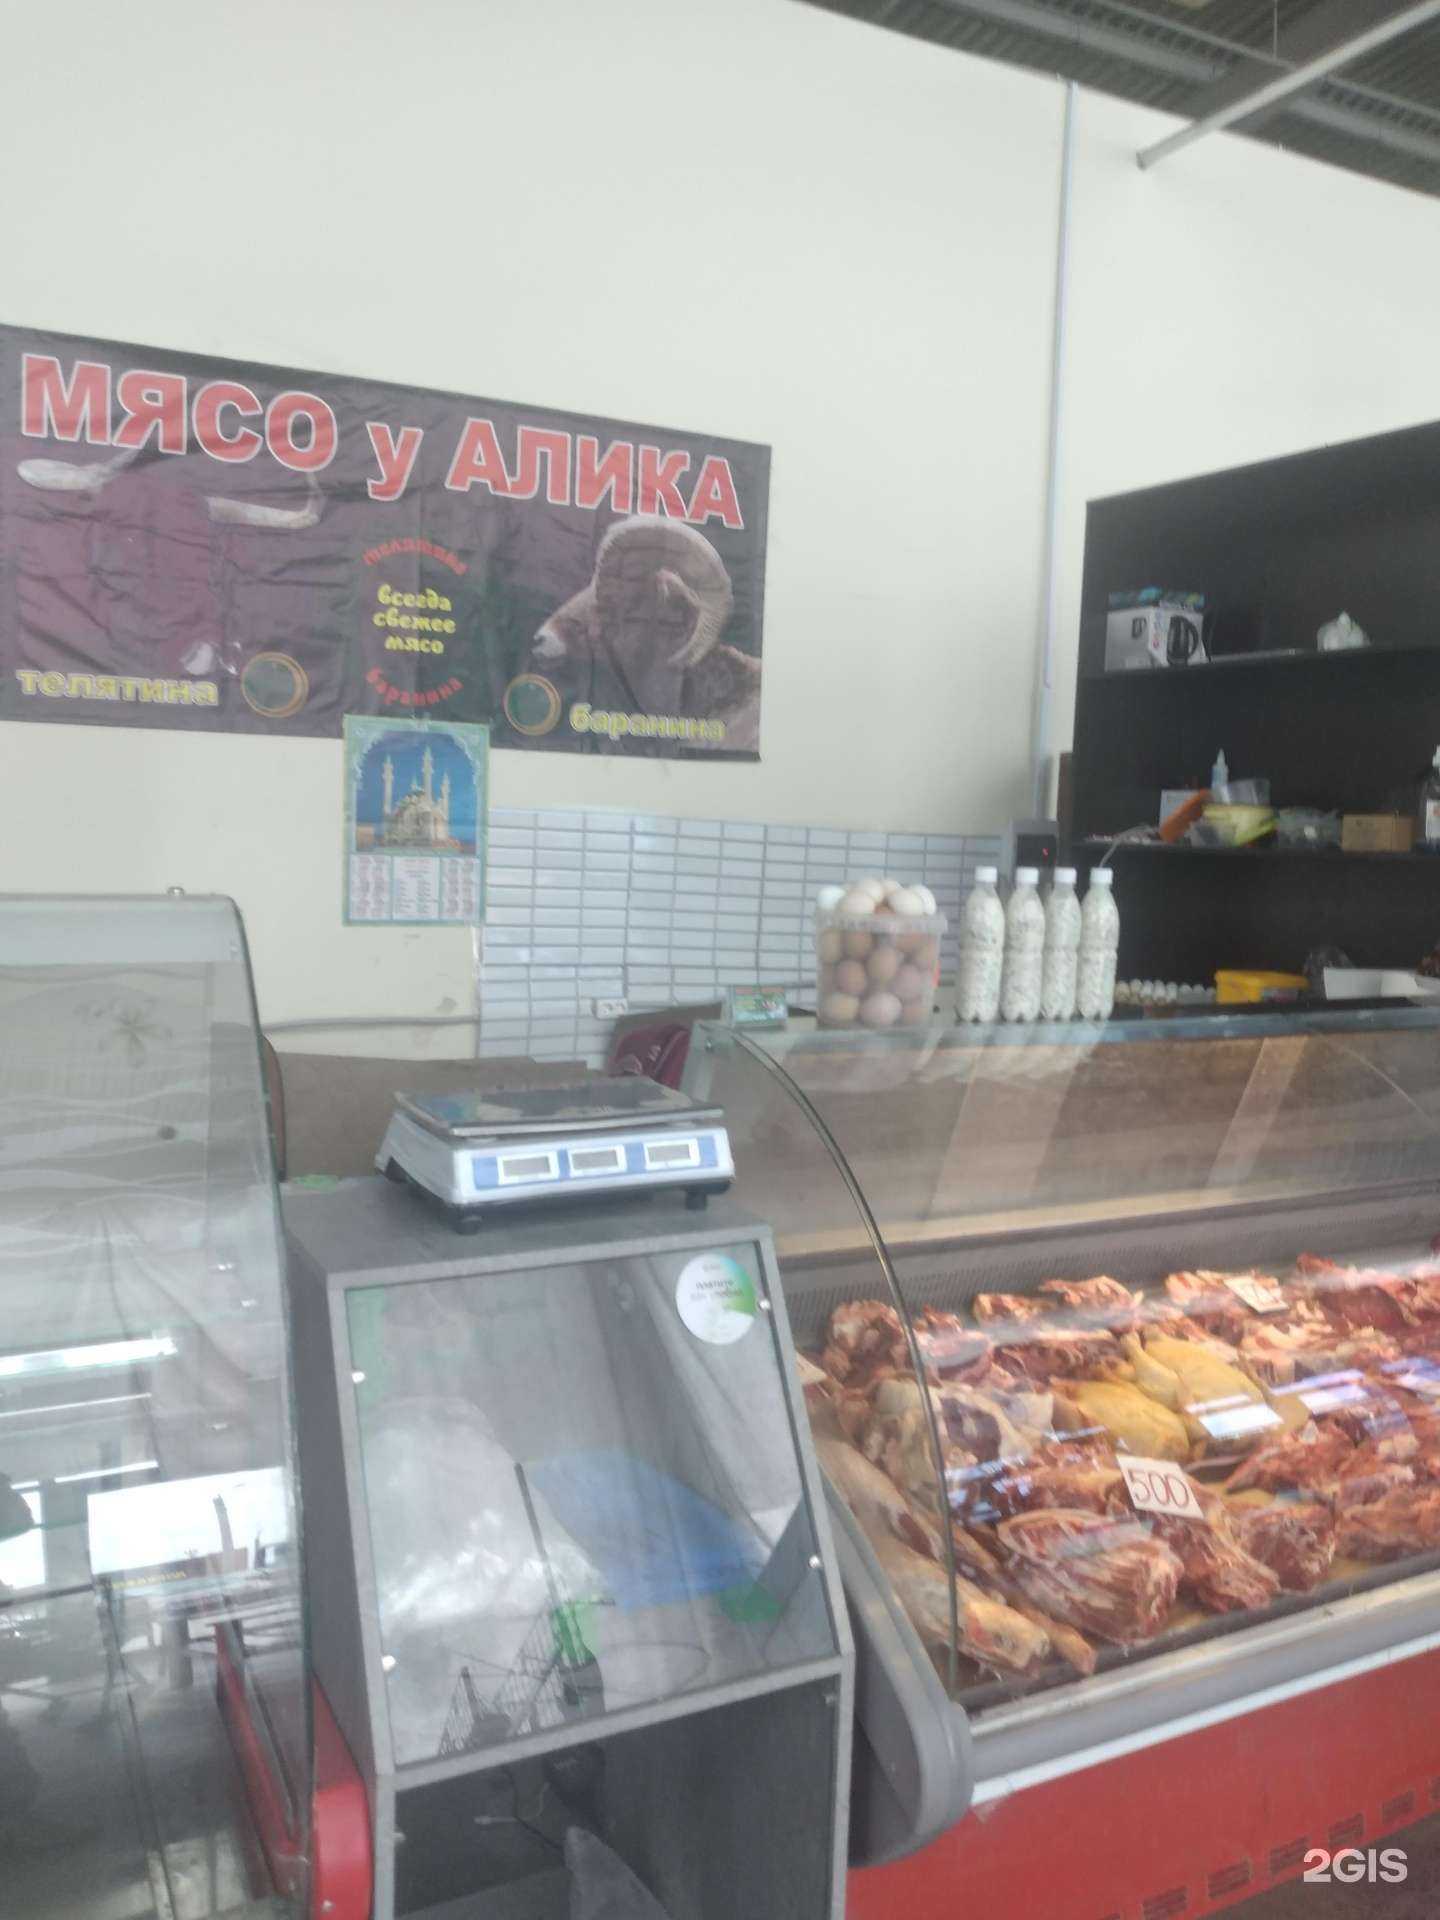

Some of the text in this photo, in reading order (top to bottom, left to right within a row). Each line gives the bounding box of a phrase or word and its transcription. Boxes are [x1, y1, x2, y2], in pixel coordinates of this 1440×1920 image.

[22, 353, 337, 472] МЯСО
[445, 417, 745, 529] АЛИКА
[377, 583, 452, 612] всегда
[373, 607, 456, 634] свежее
[384, 635, 444, 654] мясо
[16, 669, 219, 706] телятина
[569, 702, 726, 742] баранина
[1127, 1468, 1189, 1507] 500
